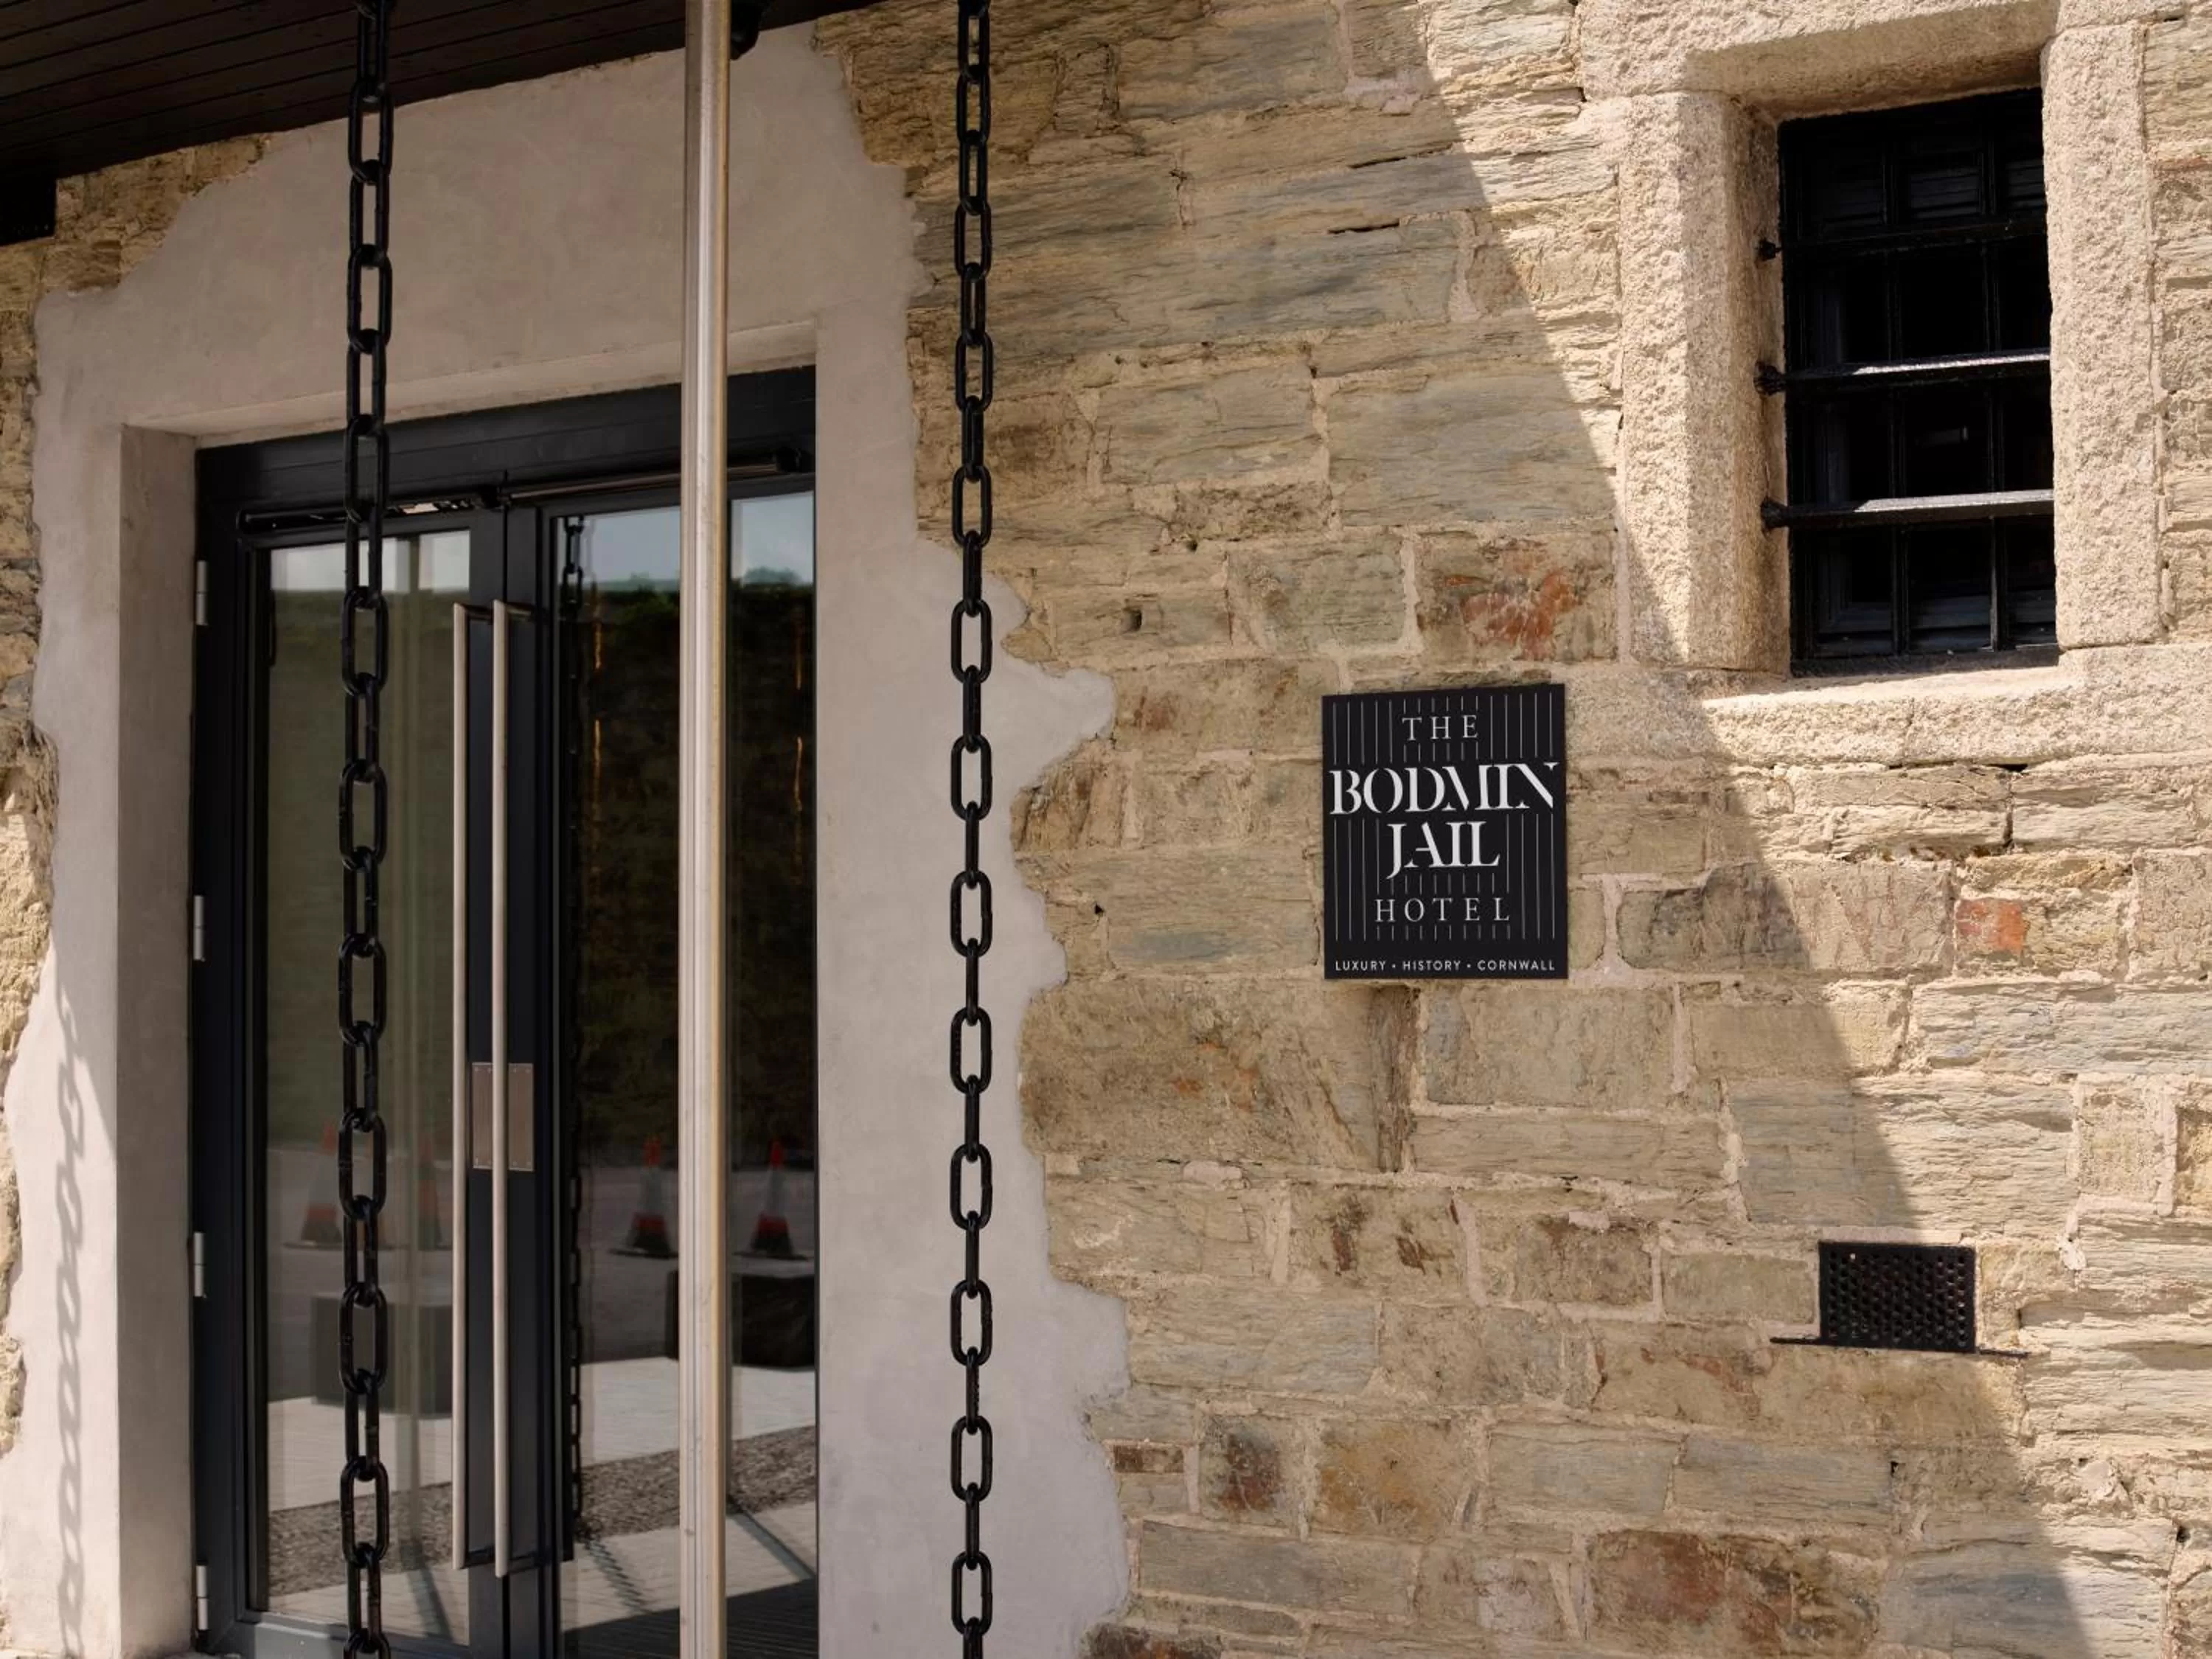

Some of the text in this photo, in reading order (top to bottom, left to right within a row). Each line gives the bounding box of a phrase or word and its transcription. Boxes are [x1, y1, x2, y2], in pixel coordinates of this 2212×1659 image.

[1402, 714, 1478, 741] THE
[1329, 762, 1560, 815] BODMIN
[1385, 821, 1501, 880] JAIL
[1374, 897, 1510, 922] HOTEL
[1335, 960, 1555, 971] LUXURY HISTORY CORNWALL
